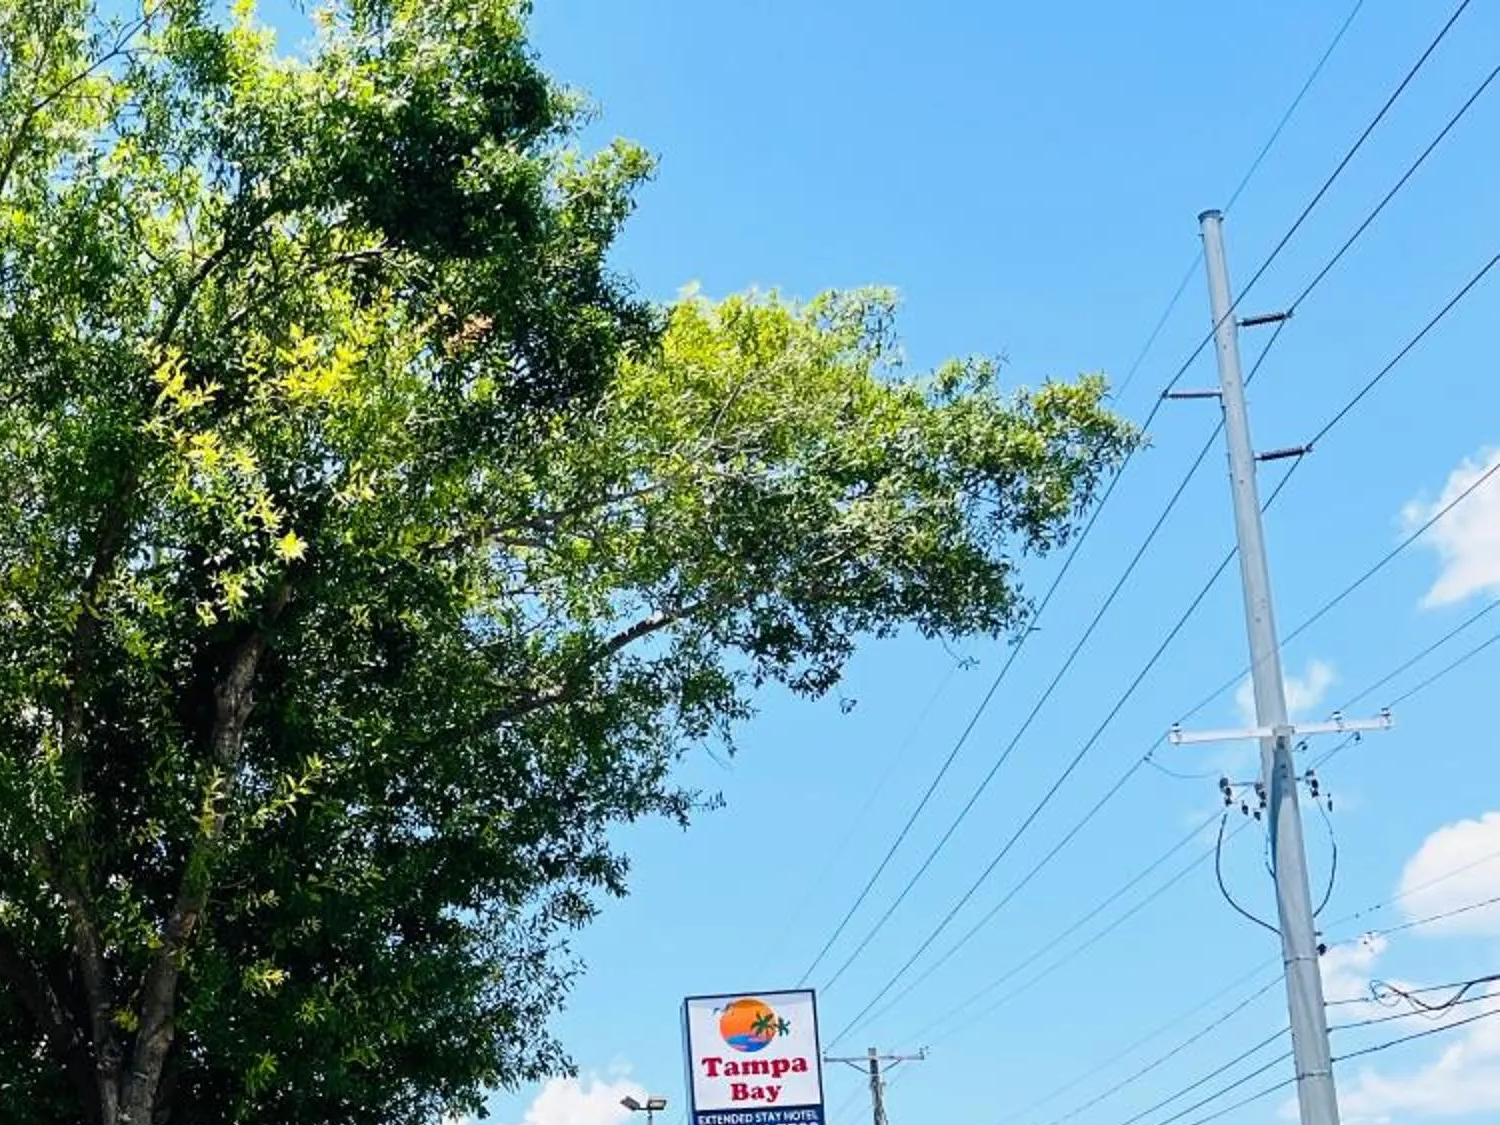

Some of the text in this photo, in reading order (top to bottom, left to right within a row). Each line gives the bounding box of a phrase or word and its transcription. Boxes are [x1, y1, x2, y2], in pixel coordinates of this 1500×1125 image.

[702, 1057, 809, 1078] Tampa
[730, 1083, 782, 1102] Bay
[697, 1109, 819, 1125] EXTENDED STAY HOTEL
